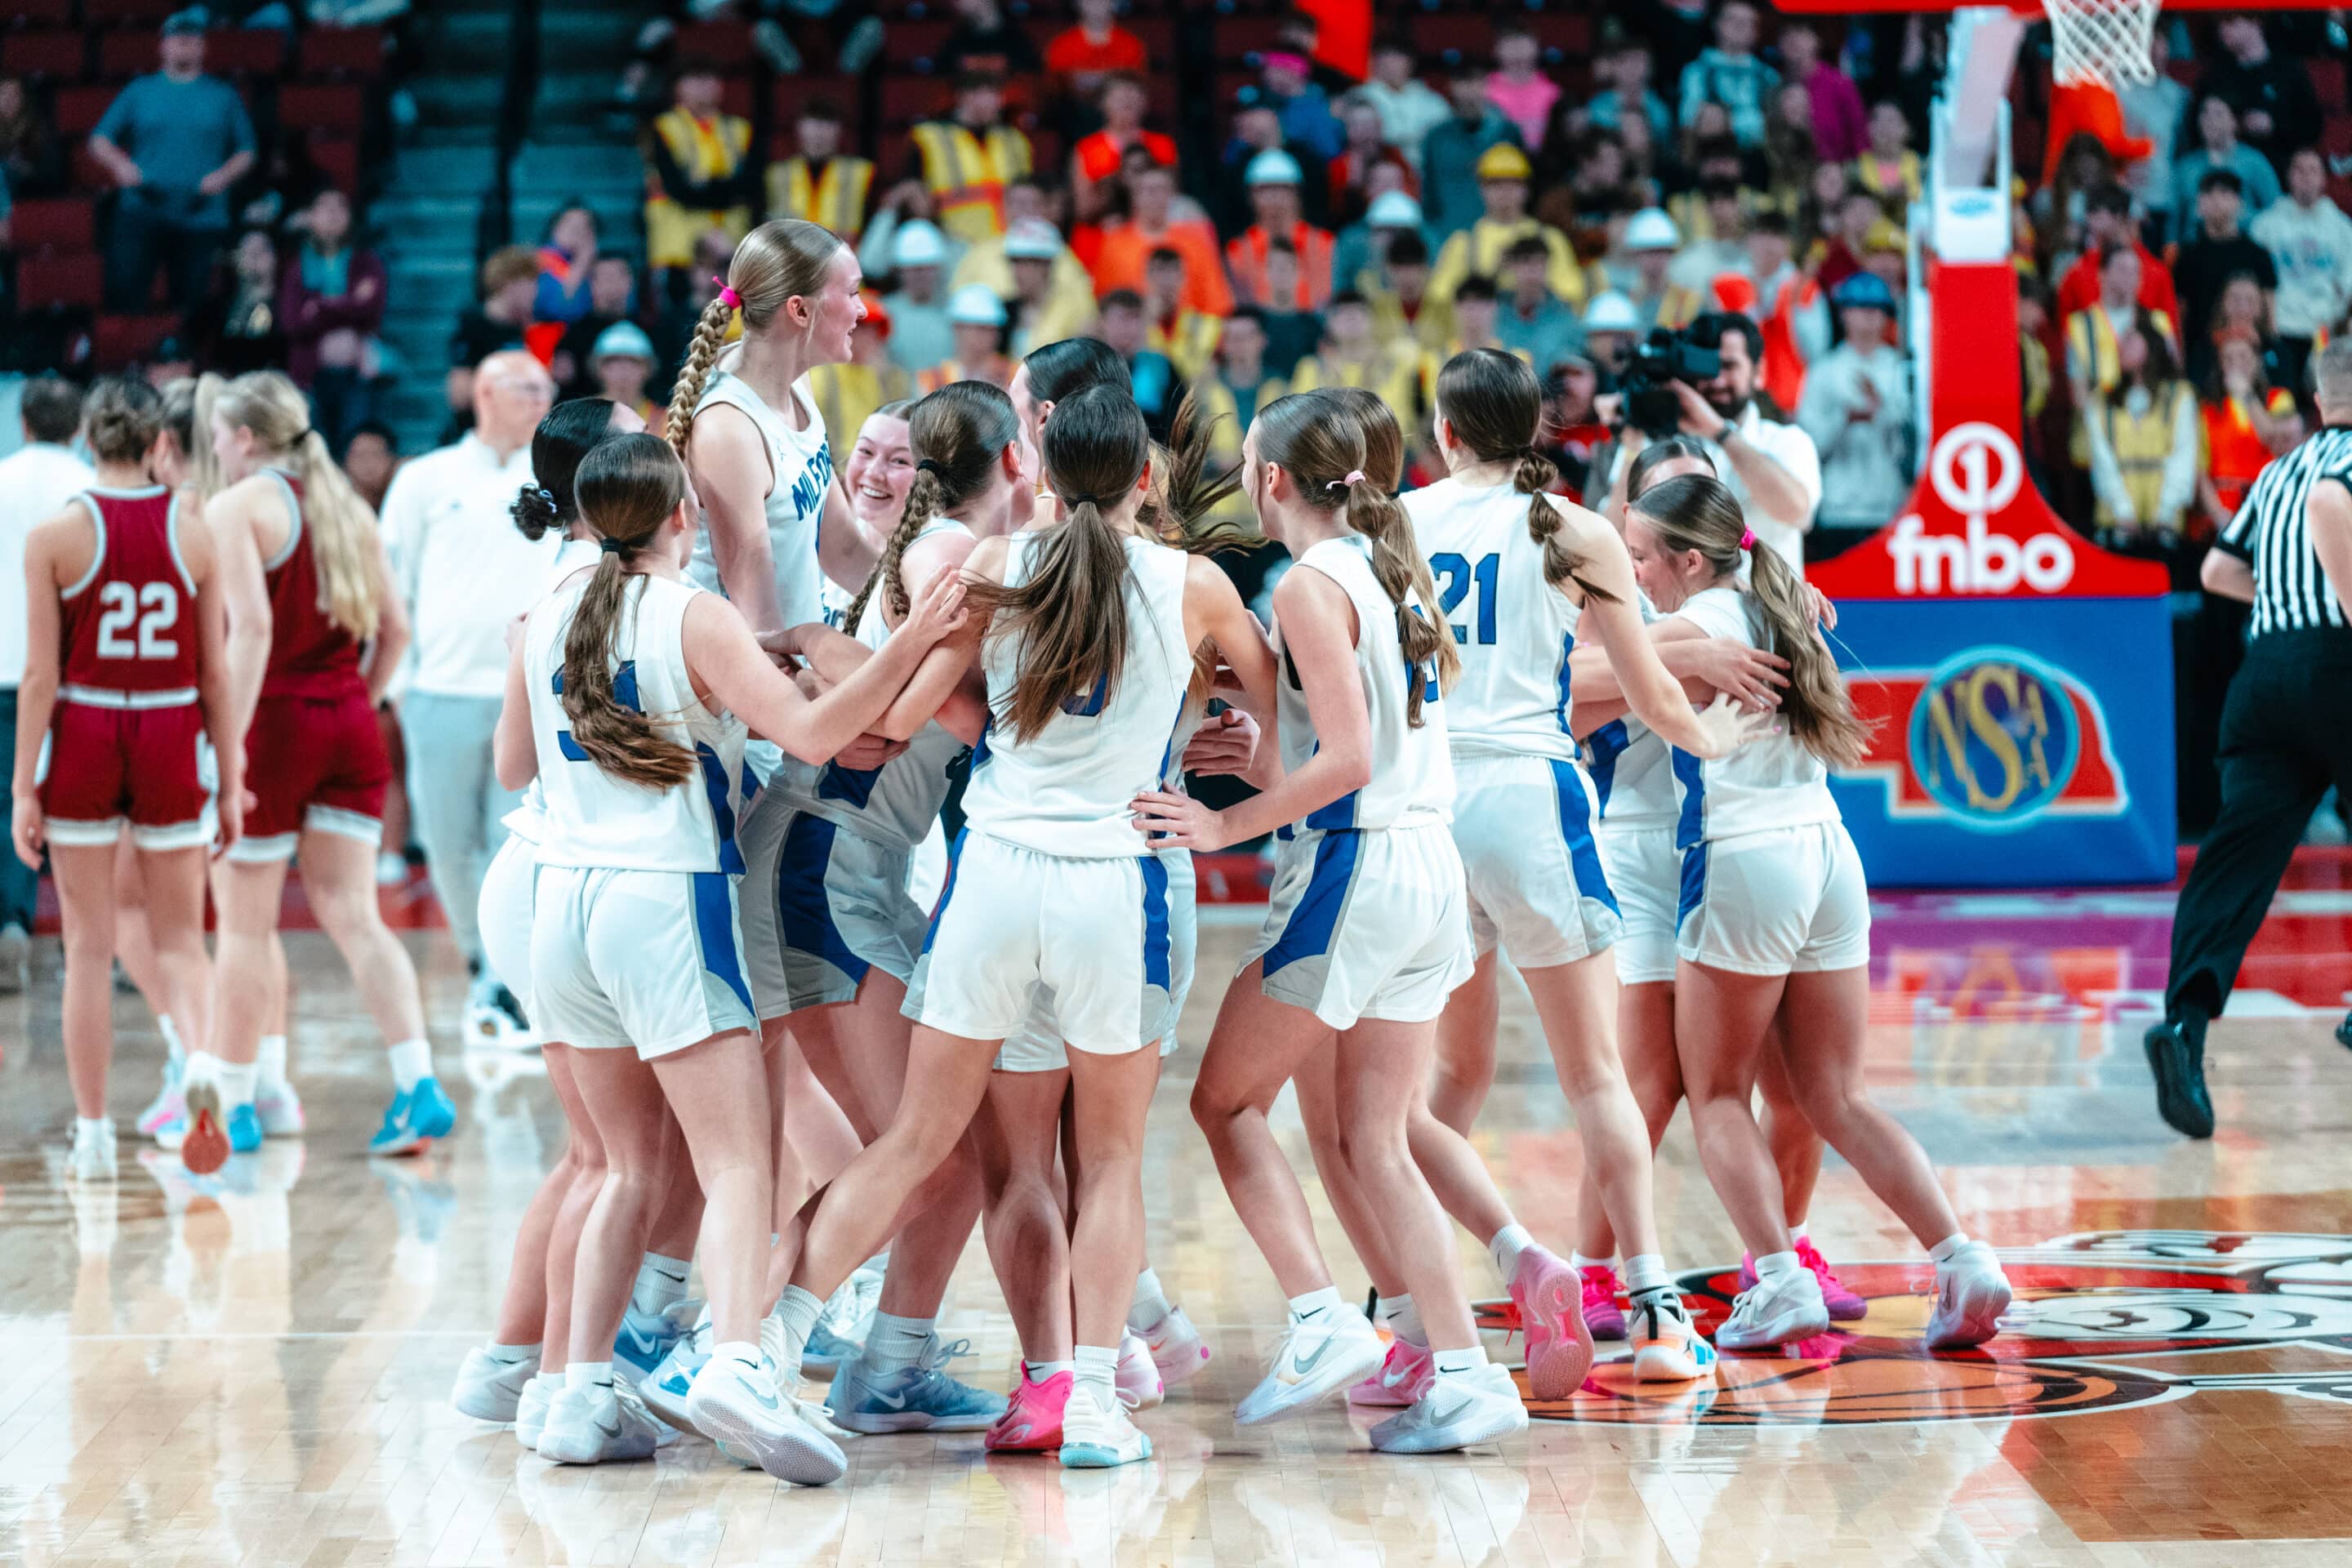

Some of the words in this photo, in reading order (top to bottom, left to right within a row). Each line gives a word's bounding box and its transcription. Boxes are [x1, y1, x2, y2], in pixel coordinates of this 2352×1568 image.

[1886, 511, 2075, 595] fnbo
[98, 581, 178, 660] 22
[1429, 552, 1500, 644] 21
